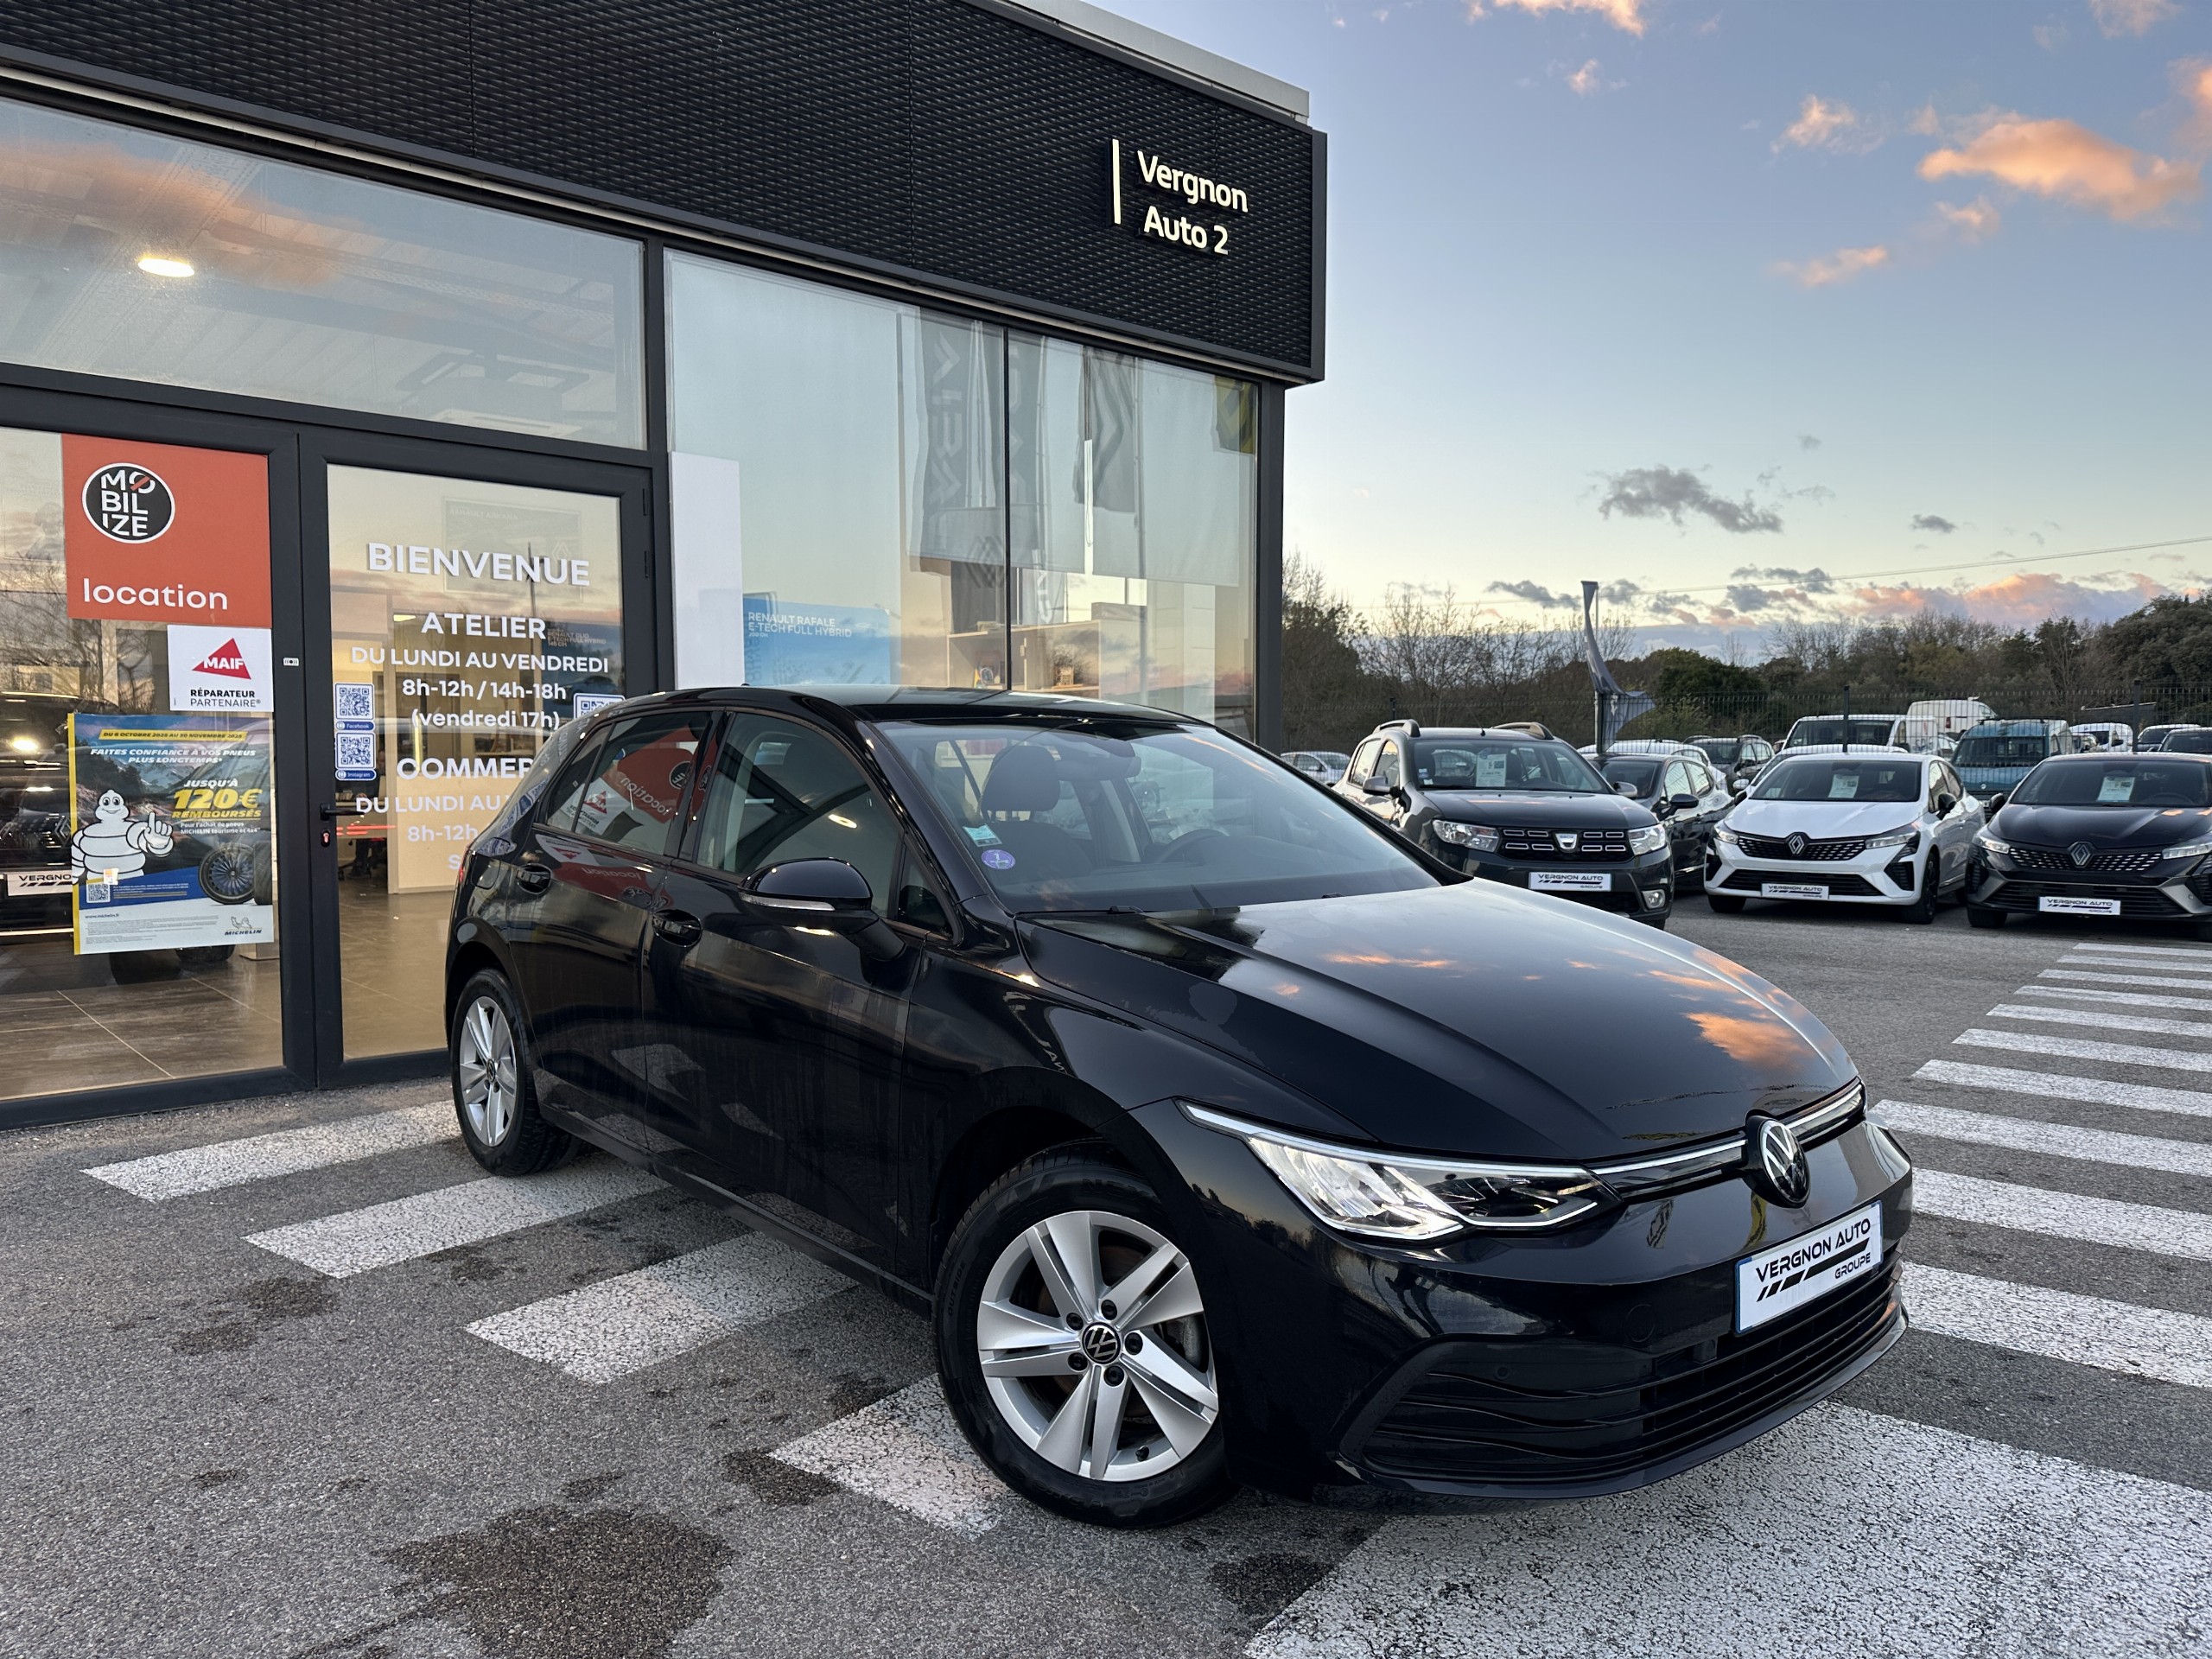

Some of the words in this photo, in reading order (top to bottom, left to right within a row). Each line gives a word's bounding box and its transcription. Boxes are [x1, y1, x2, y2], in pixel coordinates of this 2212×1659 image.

[1137, 150, 1249, 213] Vergnon
[1143, 206, 1208, 250] Auto
[1213, 225, 1229, 255] 2
[101, 490, 149, 515] BIL
[367, 542, 591, 587] BIENVENUE
[83, 577, 228, 610] location
[421, 612, 547, 639] ATELIER
[748, 612, 795, 625] RENAULT
[797, 616, 836, 627] RAFALE
[748, 623, 786, 633] E-TECH
[787, 626, 813, 636] FULL
[815, 626, 853, 638] HYBRID
[203, 656, 245, 671] MAIF
[352, 646, 386, 665] DU
[391, 648, 461, 667] LUNDI
[465, 652, 498, 670] AU
[501, 653, 609, 673] VENDREDI
[190, 686, 256, 699] RÉPARATEUR
[402, 679, 474, 698] 8h-12h
[490, 681, 568, 701] 14h-18h
[410, 709, 517, 728] (vendredi
[522, 710, 562, 730] 17h)
[183, 778, 238, 789] JUSQU'À
[171, 808, 262, 818] REMBOURSÉS
[356, 797, 389, 813] DU
[395, 795, 464, 813] LUNDI
[469, 795, 501, 811] AU
[407, 823, 479, 842] 8h-12h
[1755, 1236, 1832, 1283] VERGNON
[1834, 1217, 1872, 1249] AUTO
[1834, 1251, 1872, 1280] GROUPE
